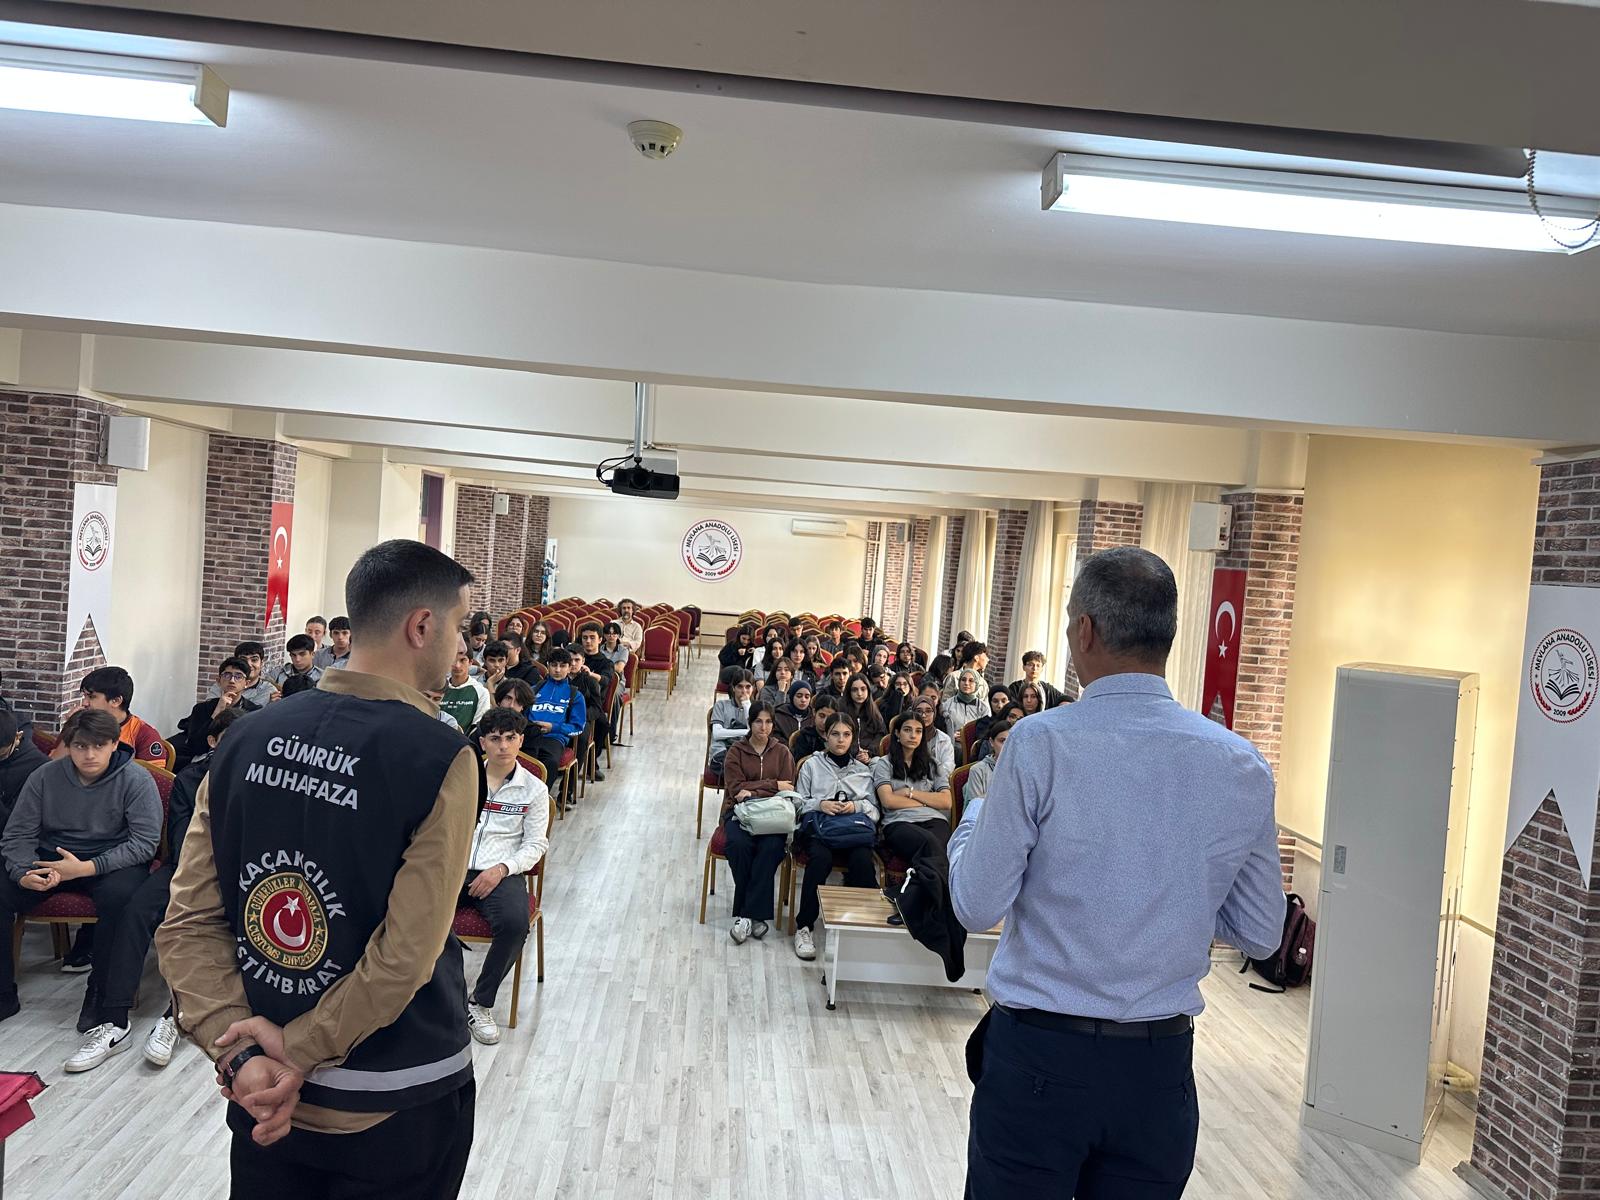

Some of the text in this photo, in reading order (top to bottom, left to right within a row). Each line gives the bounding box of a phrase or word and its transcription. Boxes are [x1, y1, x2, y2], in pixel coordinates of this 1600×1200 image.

[686, 524, 705, 548] MEVLANA
[705, 522, 733, 535] ANADOLU
[1535, 633, 1596, 680] MEVLANA ANADOLU LİSESİ
[1553, 708, 1567, 717] 2009
[267, 735, 360, 776] GÜMRÜK
[245, 763, 358, 810] MUHAFAZA
[239, 849, 347, 920] KAÇAKÇILIK
[250, 877, 296, 910] GÜMRÜKLER
[248, 925, 281, 960] CUSTOMS
